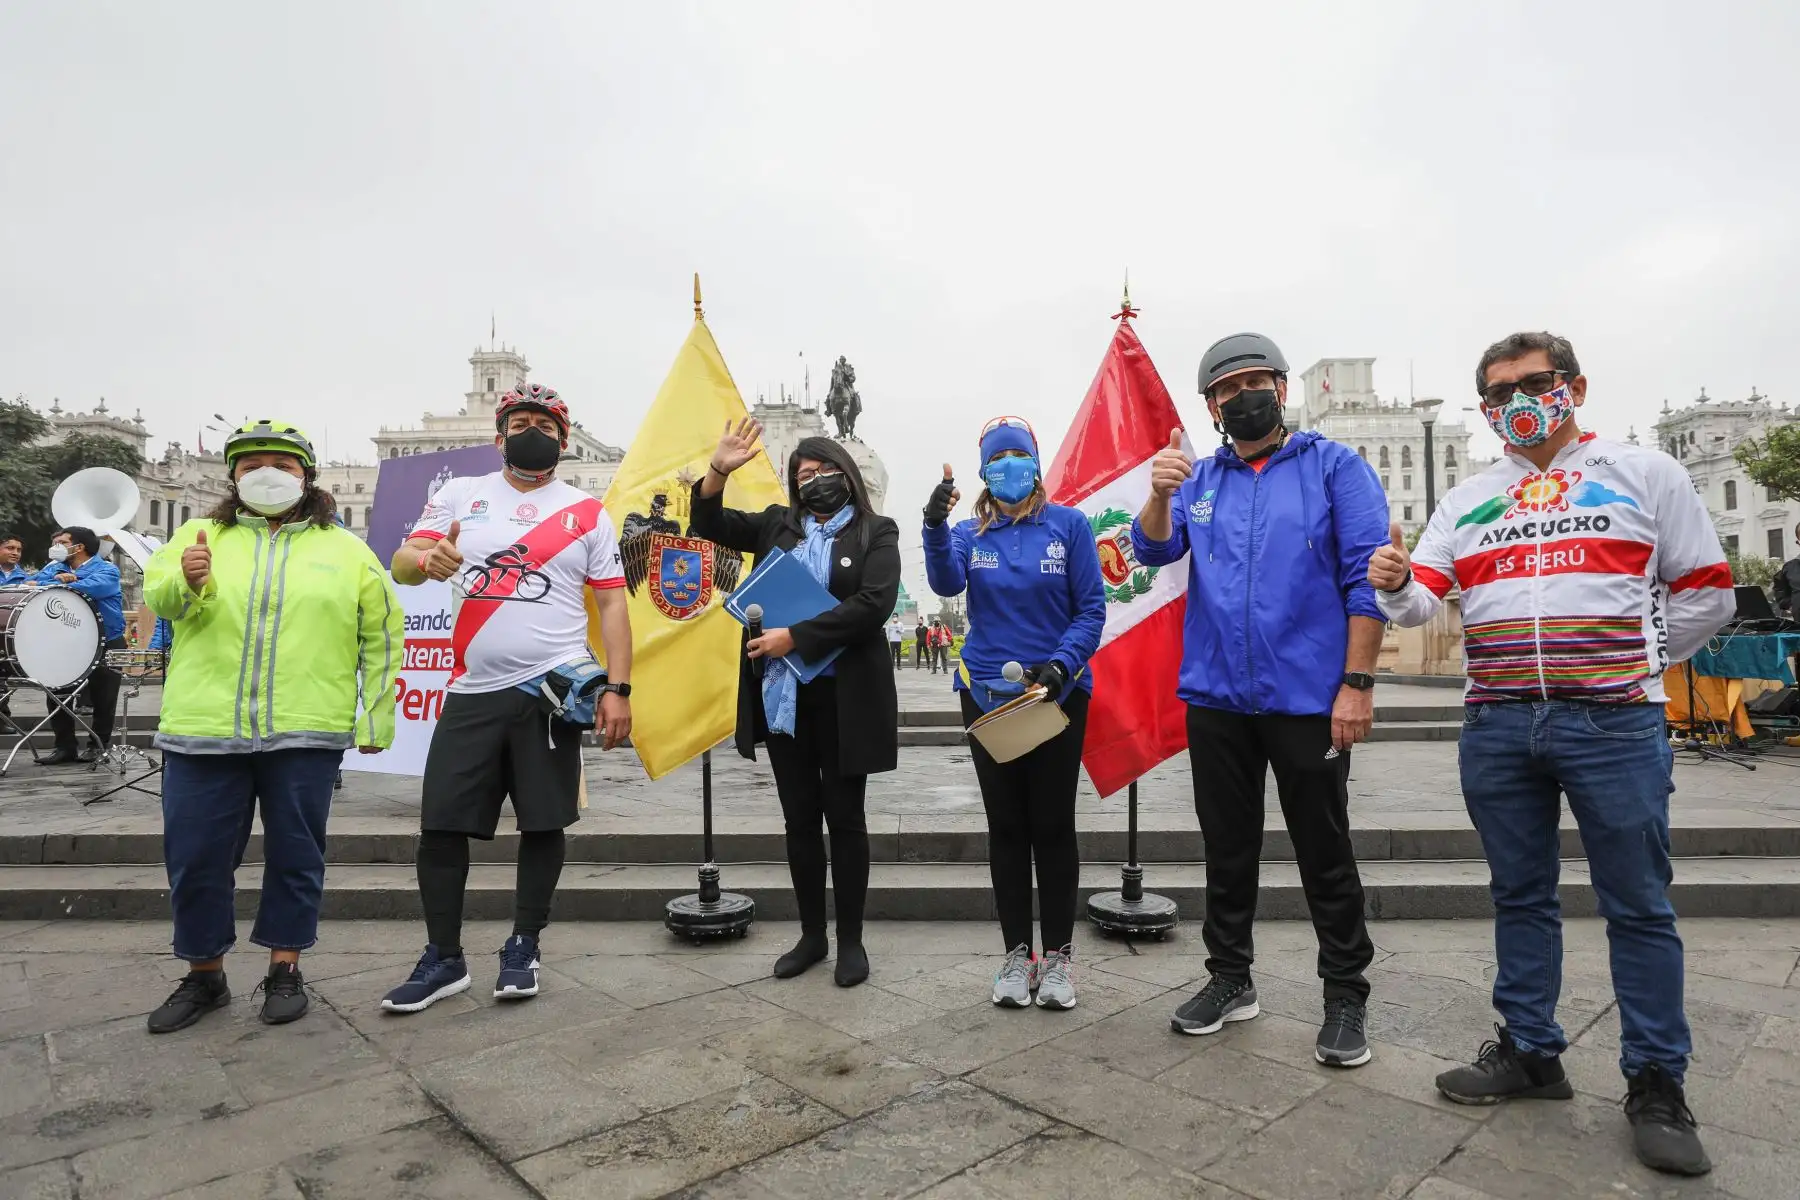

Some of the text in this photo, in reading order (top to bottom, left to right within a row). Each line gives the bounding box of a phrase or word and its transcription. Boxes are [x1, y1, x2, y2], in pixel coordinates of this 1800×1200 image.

[653, 536, 682, 548] HOC
[1478, 514, 1611, 547] AYACUCHO
[977, 555, 999, 563] LIMA
[1494, 544, 1586, 575] ES PERÚ
[403, 608, 452, 631] eando
[401, 644, 455, 669] ntena
